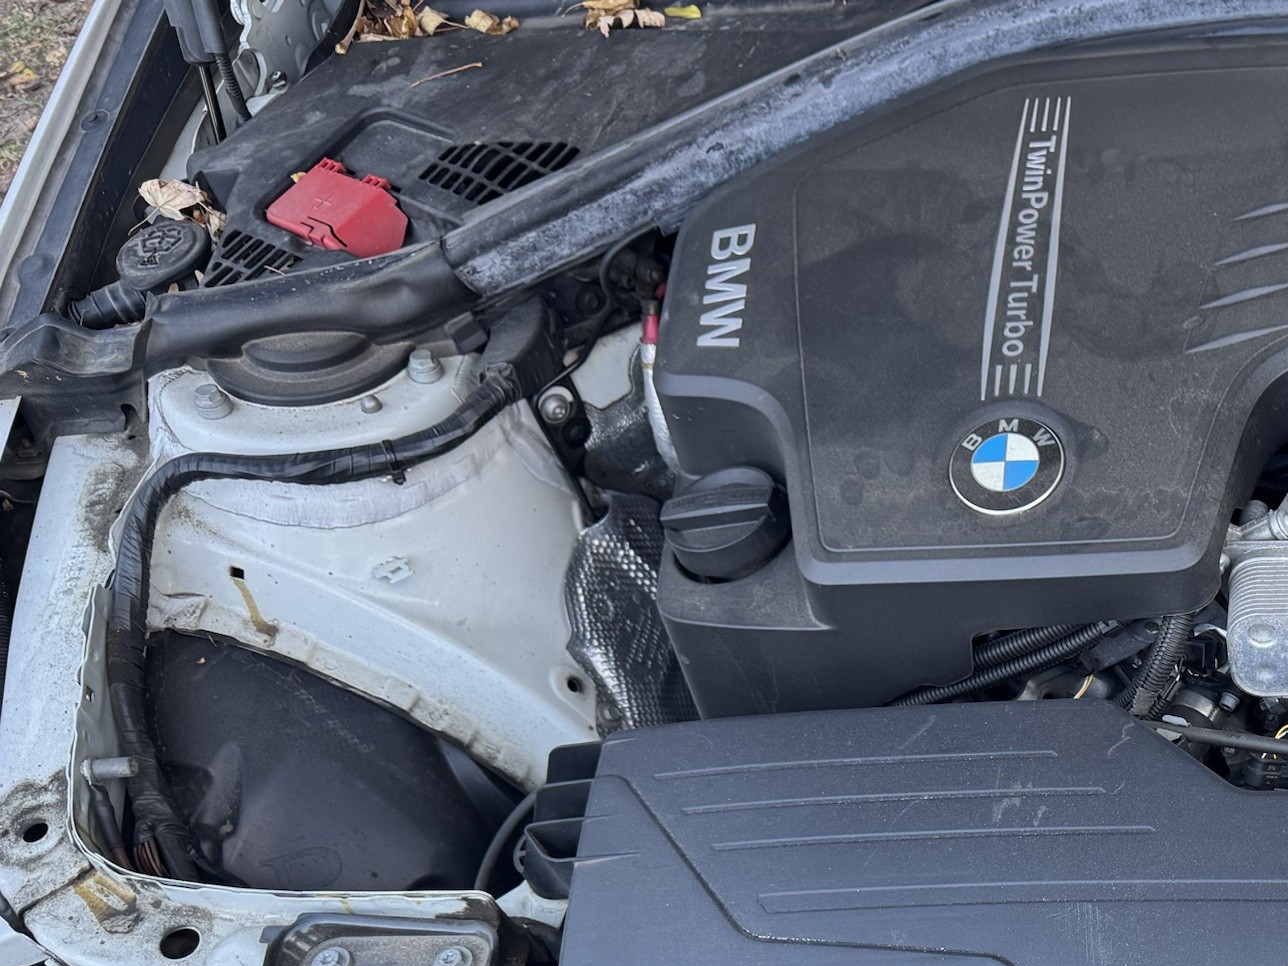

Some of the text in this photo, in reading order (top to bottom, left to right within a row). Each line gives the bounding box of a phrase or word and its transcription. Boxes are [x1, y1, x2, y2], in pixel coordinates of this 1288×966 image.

[696, 223, 756, 347] BMW
[1002, 135, 1056, 357] TwinPower Turbo
[961, 418, 1055, 451] BMW
